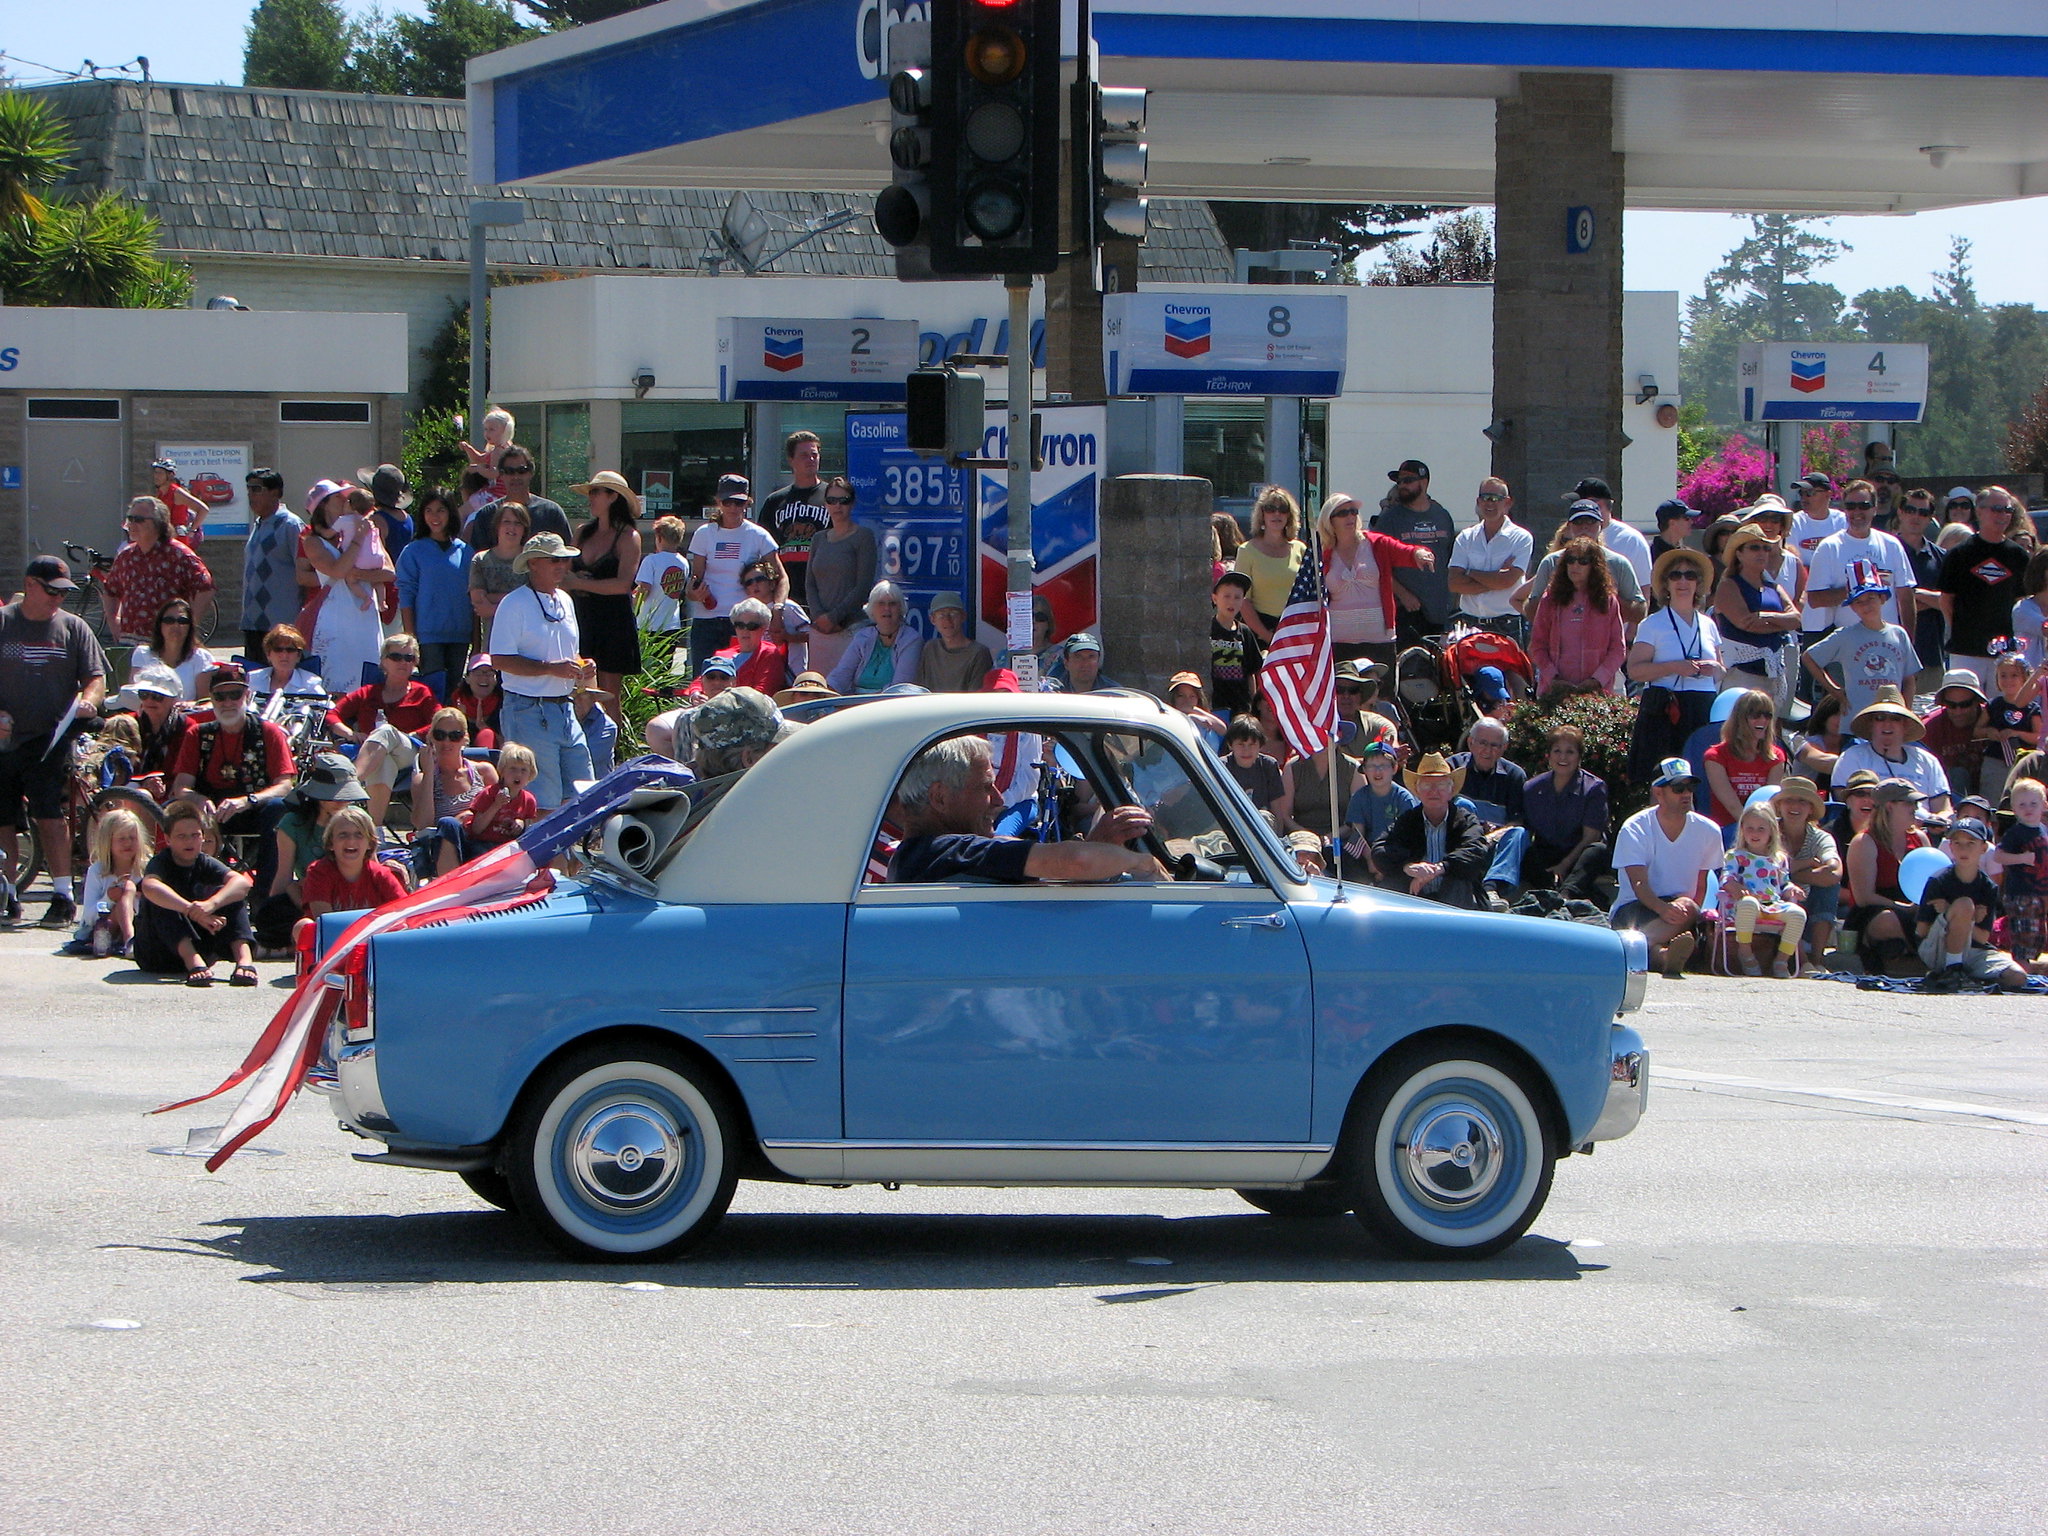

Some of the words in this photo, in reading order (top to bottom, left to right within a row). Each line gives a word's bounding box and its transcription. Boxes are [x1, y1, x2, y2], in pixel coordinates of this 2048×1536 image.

[1580, 219, 1588, 240] 8
[1164, 304, 1211, 315] Chevron
[1106, 319, 1122, 336] Self
[1267, 305, 1291, 337] 8
[764, 327, 804, 337] Chevron
[851, 328, 871, 355] 2
[1791, 350, 1826, 360] Chevron
[1868, 351, 1886, 375] 4
[1742, 362, 1758, 376] Self
[1206, 380, 1252, 391] TECHRON
[851, 421, 899, 440] Gasoline
[850, 476, 878, 487] Regular
[884, 466, 945, 506] 385
[883, 536, 944, 576] 397
